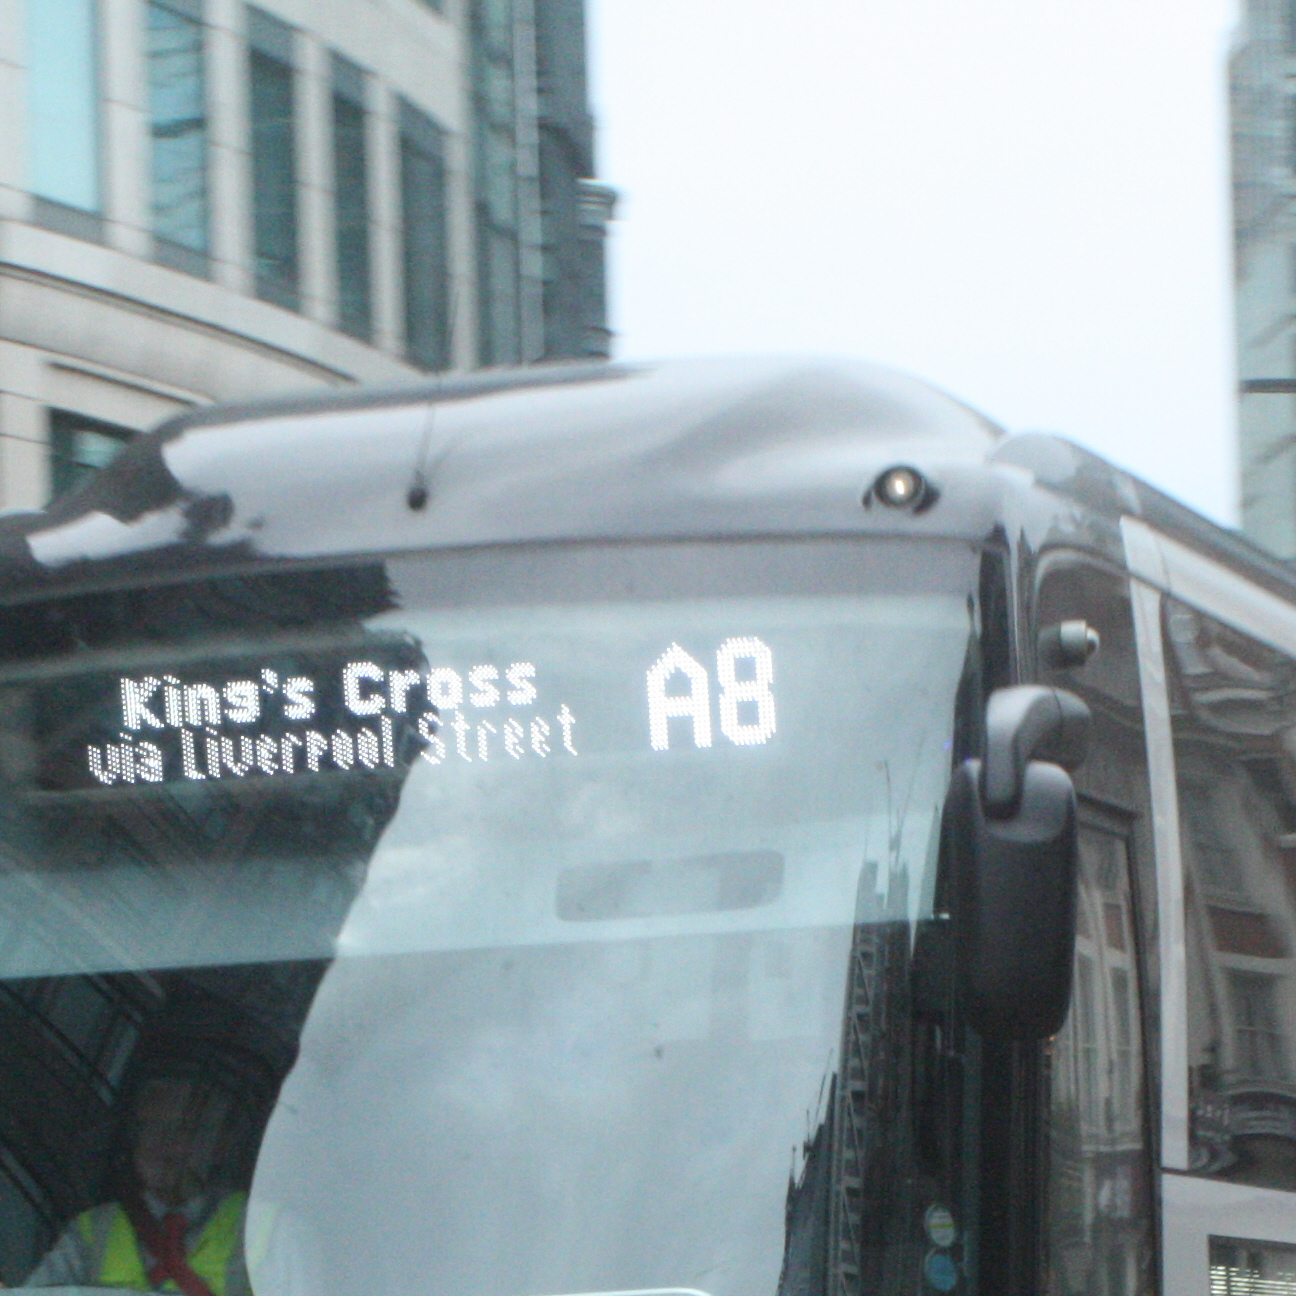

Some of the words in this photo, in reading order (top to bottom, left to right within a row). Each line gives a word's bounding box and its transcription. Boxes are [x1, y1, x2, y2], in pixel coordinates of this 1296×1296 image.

[120, 665, 316, 731] King's
[342, 661, 537, 717] Cross
[646, 636, 777, 752] A8
[87, 731, 164, 786] via
[181, 714, 395, 781] Liverpool
[418, 703, 578, 766] Street
